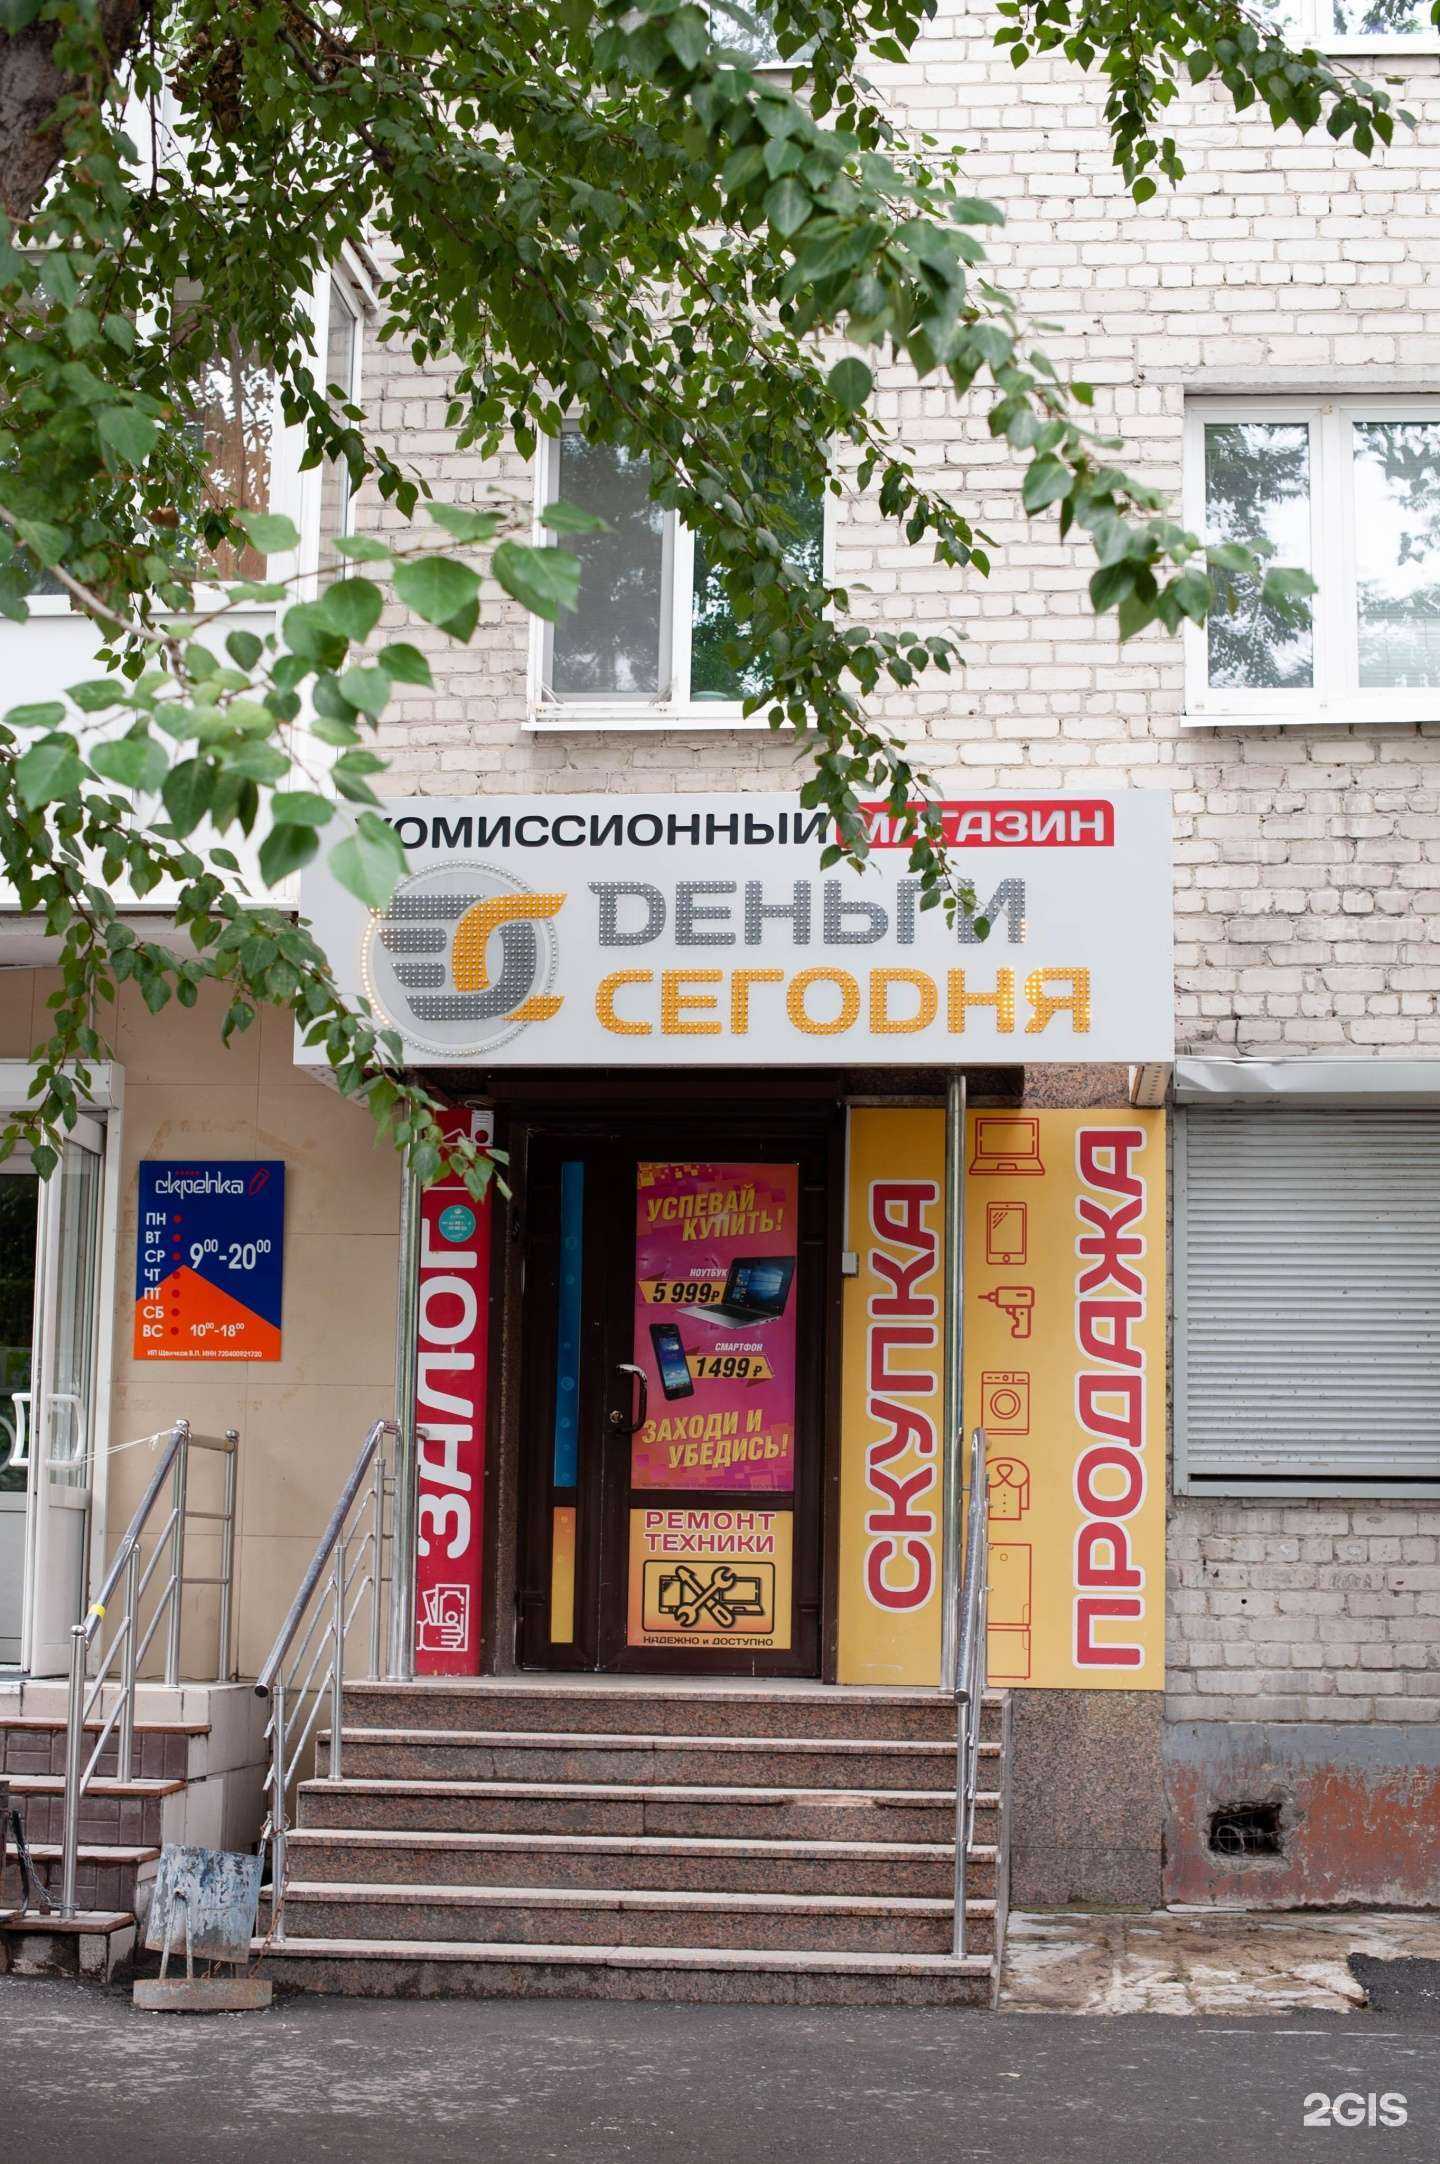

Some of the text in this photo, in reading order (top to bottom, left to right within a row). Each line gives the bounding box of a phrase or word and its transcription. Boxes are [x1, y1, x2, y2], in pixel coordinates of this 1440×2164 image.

[355, 812, 828, 850] ОМИССИОННЫЙ
[648, 1184, 756, 1222] УСПЕВАЙ
[146, 1212, 166, 1225] ПН
[682, 1208, 784, 1241] КУПИТЬ!
[145, 1231, 161, 1244] ВТ
[145, 1250, 166, 1263] СР
[144, 1269, 161, 1282] ЧТ
[690, 1268, 728, 1277] НОУТБУК
[143, 1287, 161, 1300] ПТ
[142, 1306, 165, 1319] СБ
[142, 1324, 164, 1338] ВС
[715, 1343, 763, 1352] СМАРТФОН
[417, 1218, 478, 1560] ЗАЛОГ
[865, 1180, 938, 1612] СКУПКА
[1073, 1127, 1146, 1669] ПРОДАЖА
[641, 1409, 763, 1443] ЗАХОДИ И
[668, 1433, 793, 1469] УБЕДИСЬ!
[645, 1511, 775, 1531] РЕМОНТ
[644, 1533, 775, 1553] ТЕХНИКИ
[643, 1636, 699, 1645] НАДЕЖНО
[712, 1637, 773, 1647] ДОСТУПНО
